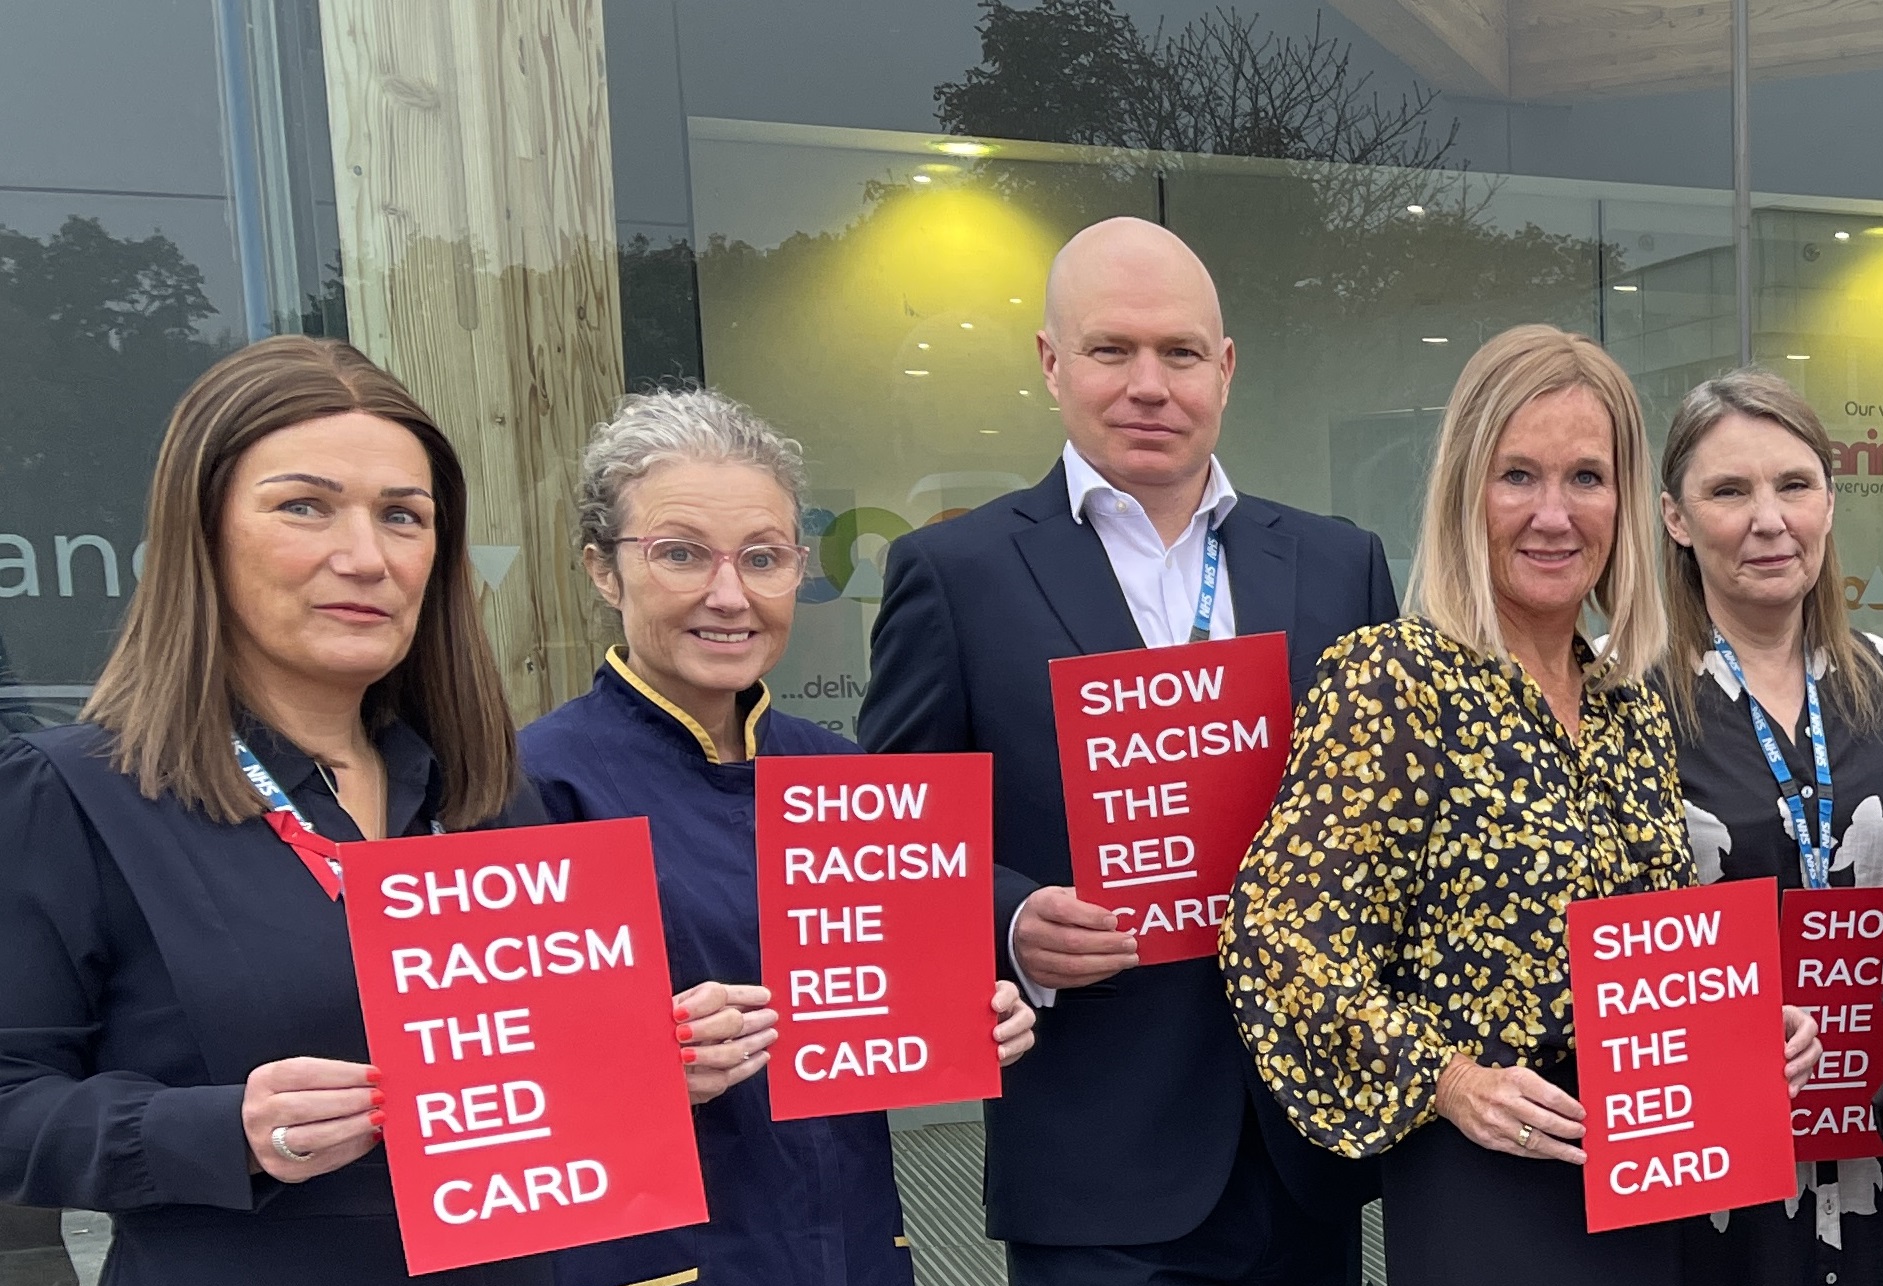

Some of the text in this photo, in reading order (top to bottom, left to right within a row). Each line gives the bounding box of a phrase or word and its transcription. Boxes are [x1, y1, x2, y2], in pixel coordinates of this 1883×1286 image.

[1845, 401, 1875, 417] Our
[1206, 537, 1219, 561] NHS
[1203, 563, 1216, 589] NHS
[1199, 591, 1213, 618] NHS
[1722, 649, 1740, 671] NHS
[1081, 666, 1224, 715] SHOW
[1751, 706, 1766, 731] NHS
[1085, 716, 1269, 772] RACISM
[1762, 737, 1782, 763] NHS
[243, 764, 280, 797] NHS
[784, 784, 927, 822] SHOW
[1093, 782, 1189, 823] THE
[1796, 818, 1811, 845] NHS
[786, 843, 966, 884] RACISM
[1098, 835, 1195, 876] RED
[1804, 853, 1817, 880] NHS
[381, 859, 570, 918] SHOW
[788, 906, 883, 945] THE
[1593, 911, 1720, 959] SHOW
[392, 925, 633, 993] RACISM
[790, 966, 887, 1007] RED
[1597, 962, 1759, 1018] RACISM
[404, 1009, 535, 1063] THE
[1602, 1029, 1687, 1072] THE
[795, 1037, 927, 1081] CARD
[1811, 1049, 1869, 1079] ED
[416, 1080, 546, 1137] RED
[1605, 1084, 1692, 1129] RED
[1610, 1147, 1729, 1194] CARD
[432, 1159, 608, 1225] CARD
